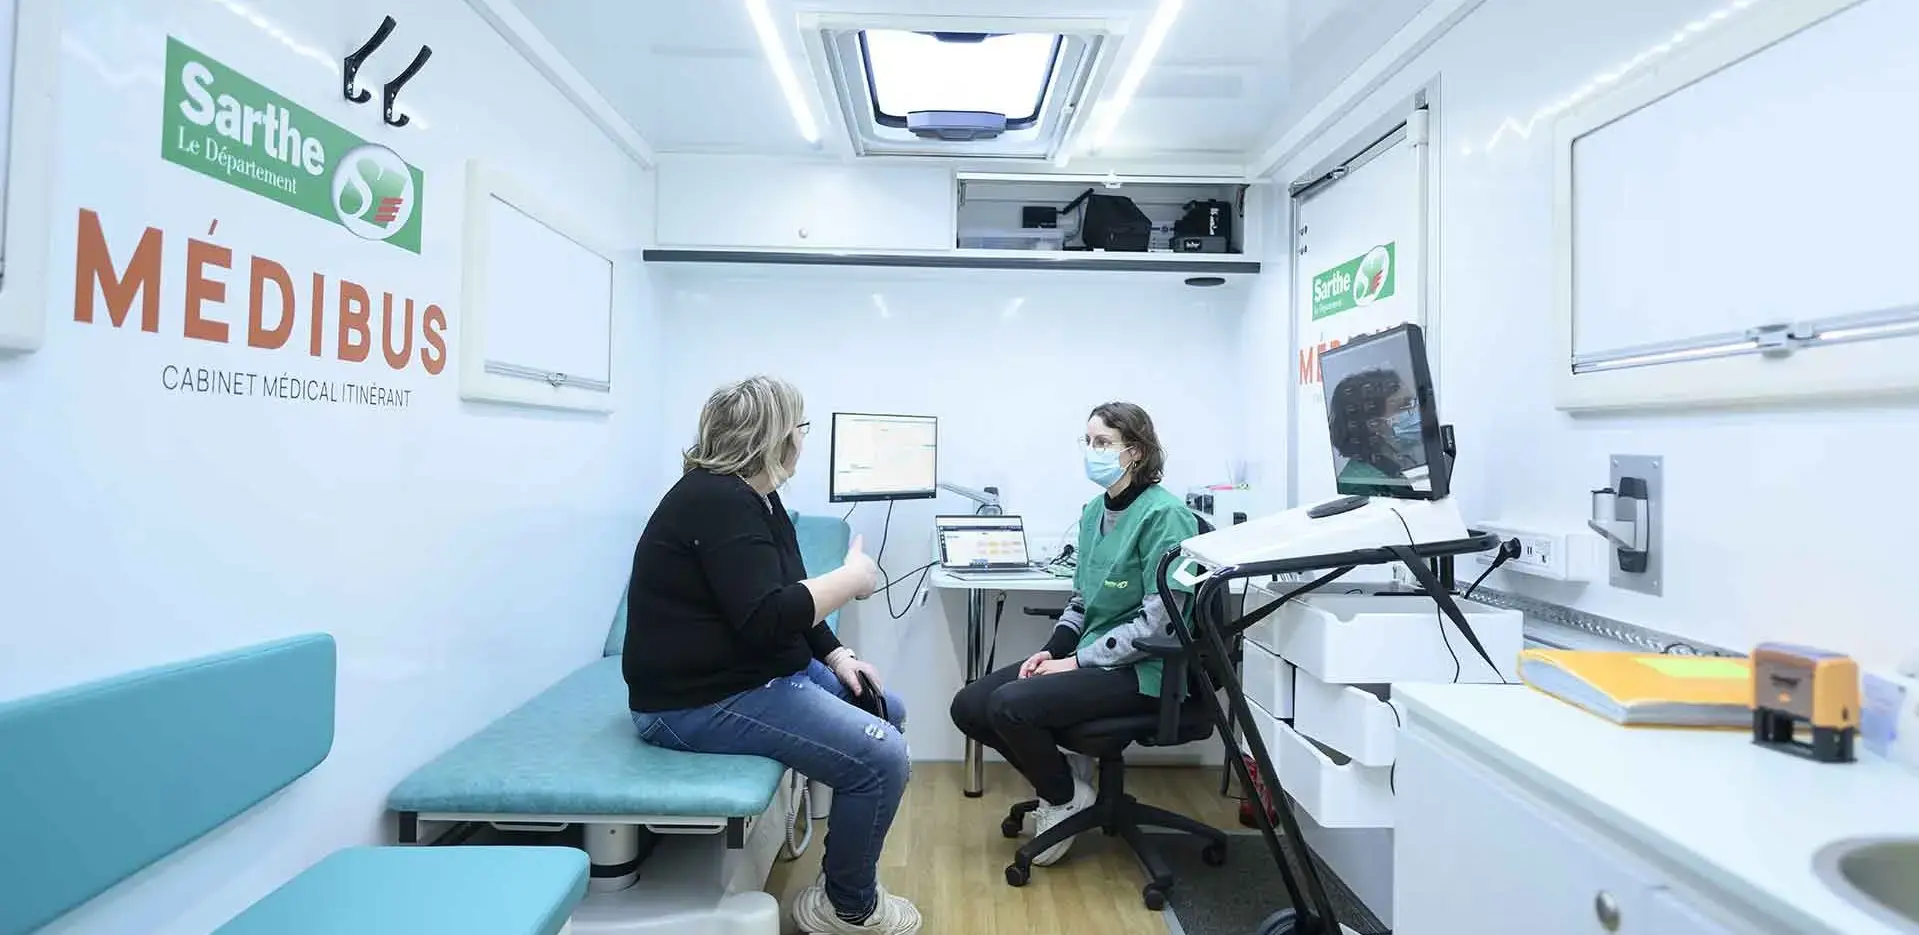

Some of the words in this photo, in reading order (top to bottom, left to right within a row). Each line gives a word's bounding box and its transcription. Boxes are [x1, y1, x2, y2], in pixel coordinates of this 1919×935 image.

[179, 61, 325, 176] Sarthe
[177, 125, 200, 155] Le
[205, 136, 297, 194] Département
[74, 207, 448, 375] MÉDIBUS
[1314, 272, 1351, 301] Sarthe
[162, 365, 257, 396] CABINET
[263, 372, 338, 403] MÉDICAL
[342, 383, 412, 408] ITINÉRANT
